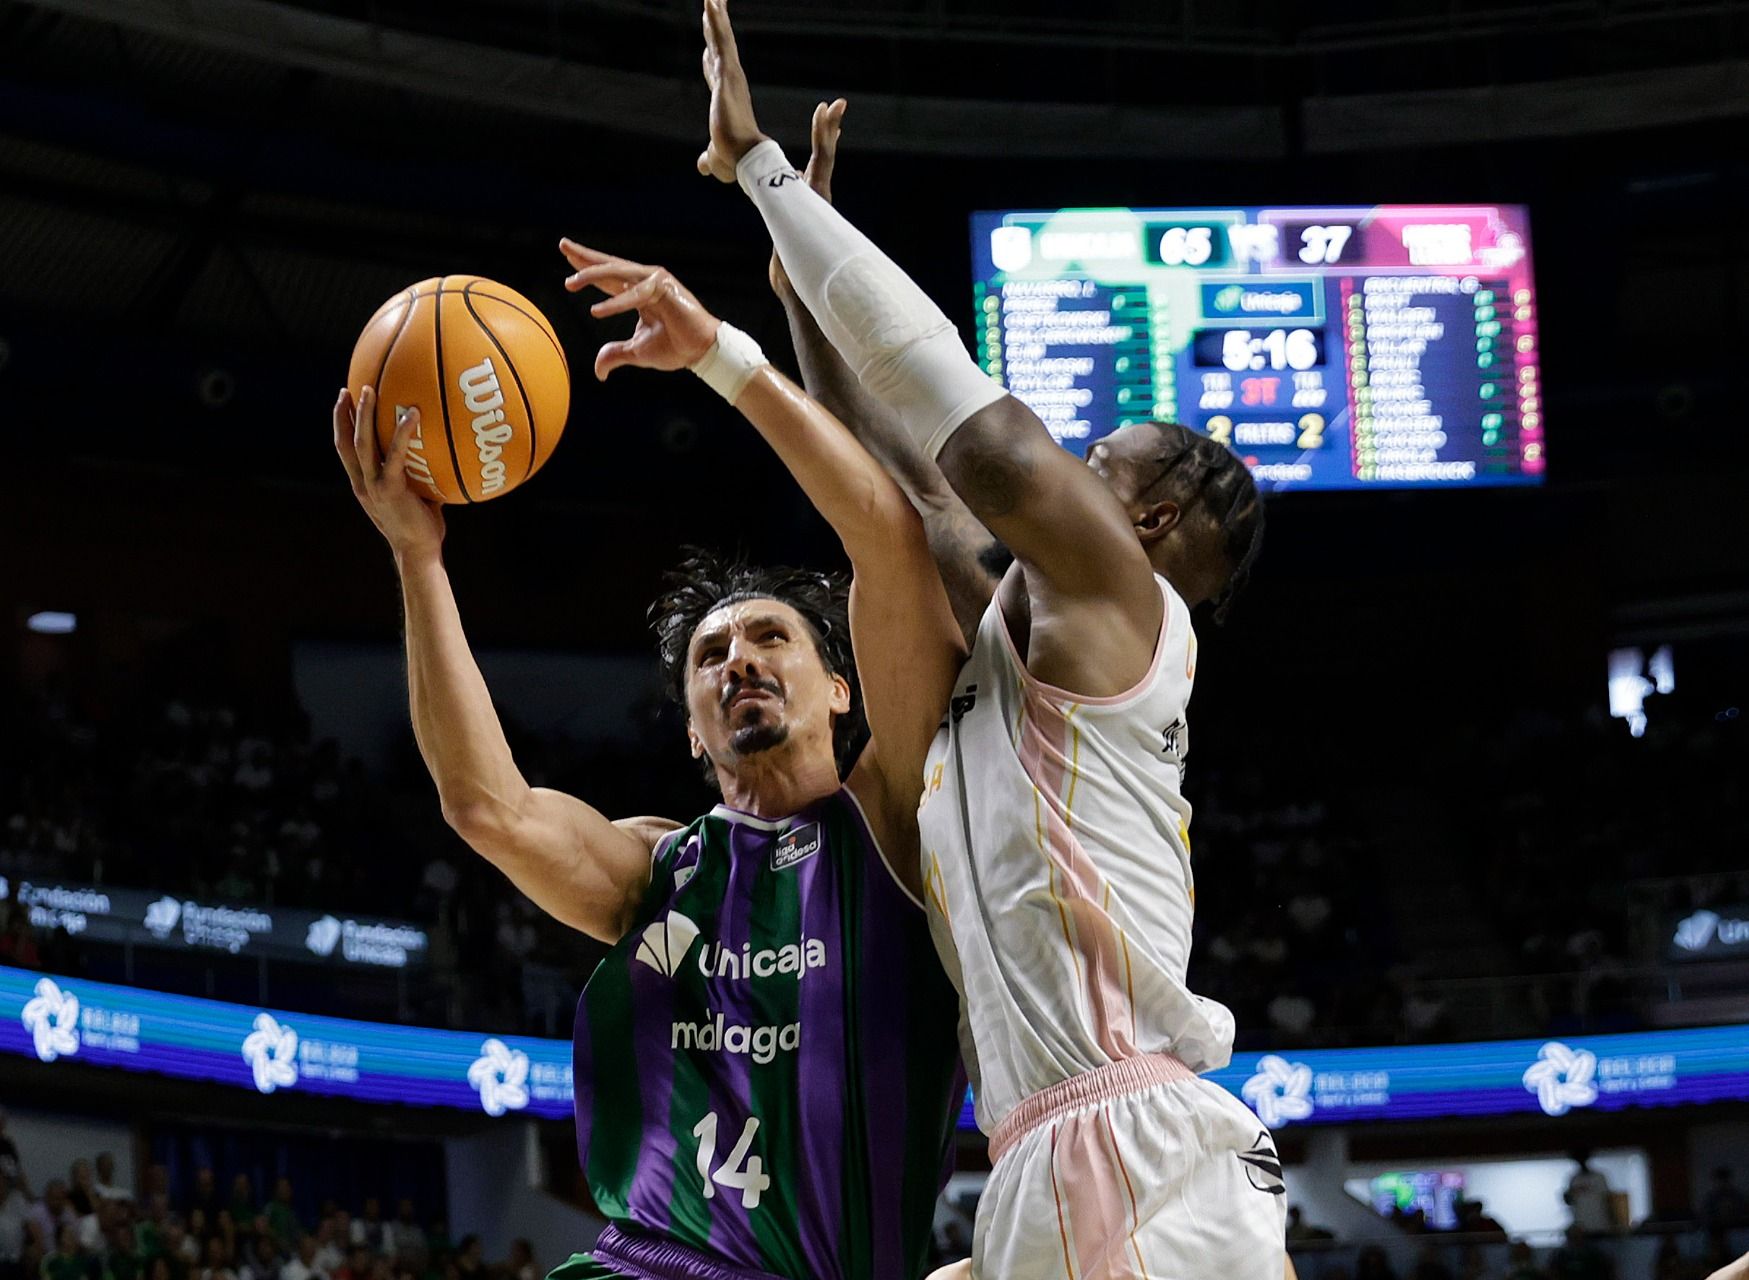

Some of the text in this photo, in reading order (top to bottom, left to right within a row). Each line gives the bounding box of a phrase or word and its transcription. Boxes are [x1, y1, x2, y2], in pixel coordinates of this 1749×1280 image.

[1159, 227, 1212, 265] 65
[1299, 225, 1352, 264] 37
[1222, 329, 1317, 371] 5:16
[458, 356, 513, 495] Wilson
[1297, 413, 1325, 449] 2
[698, 934, 827, 980] Unicaja
[671, 1008, 801, 1065] málaga
[693, 1111, 771, 1210] 14
